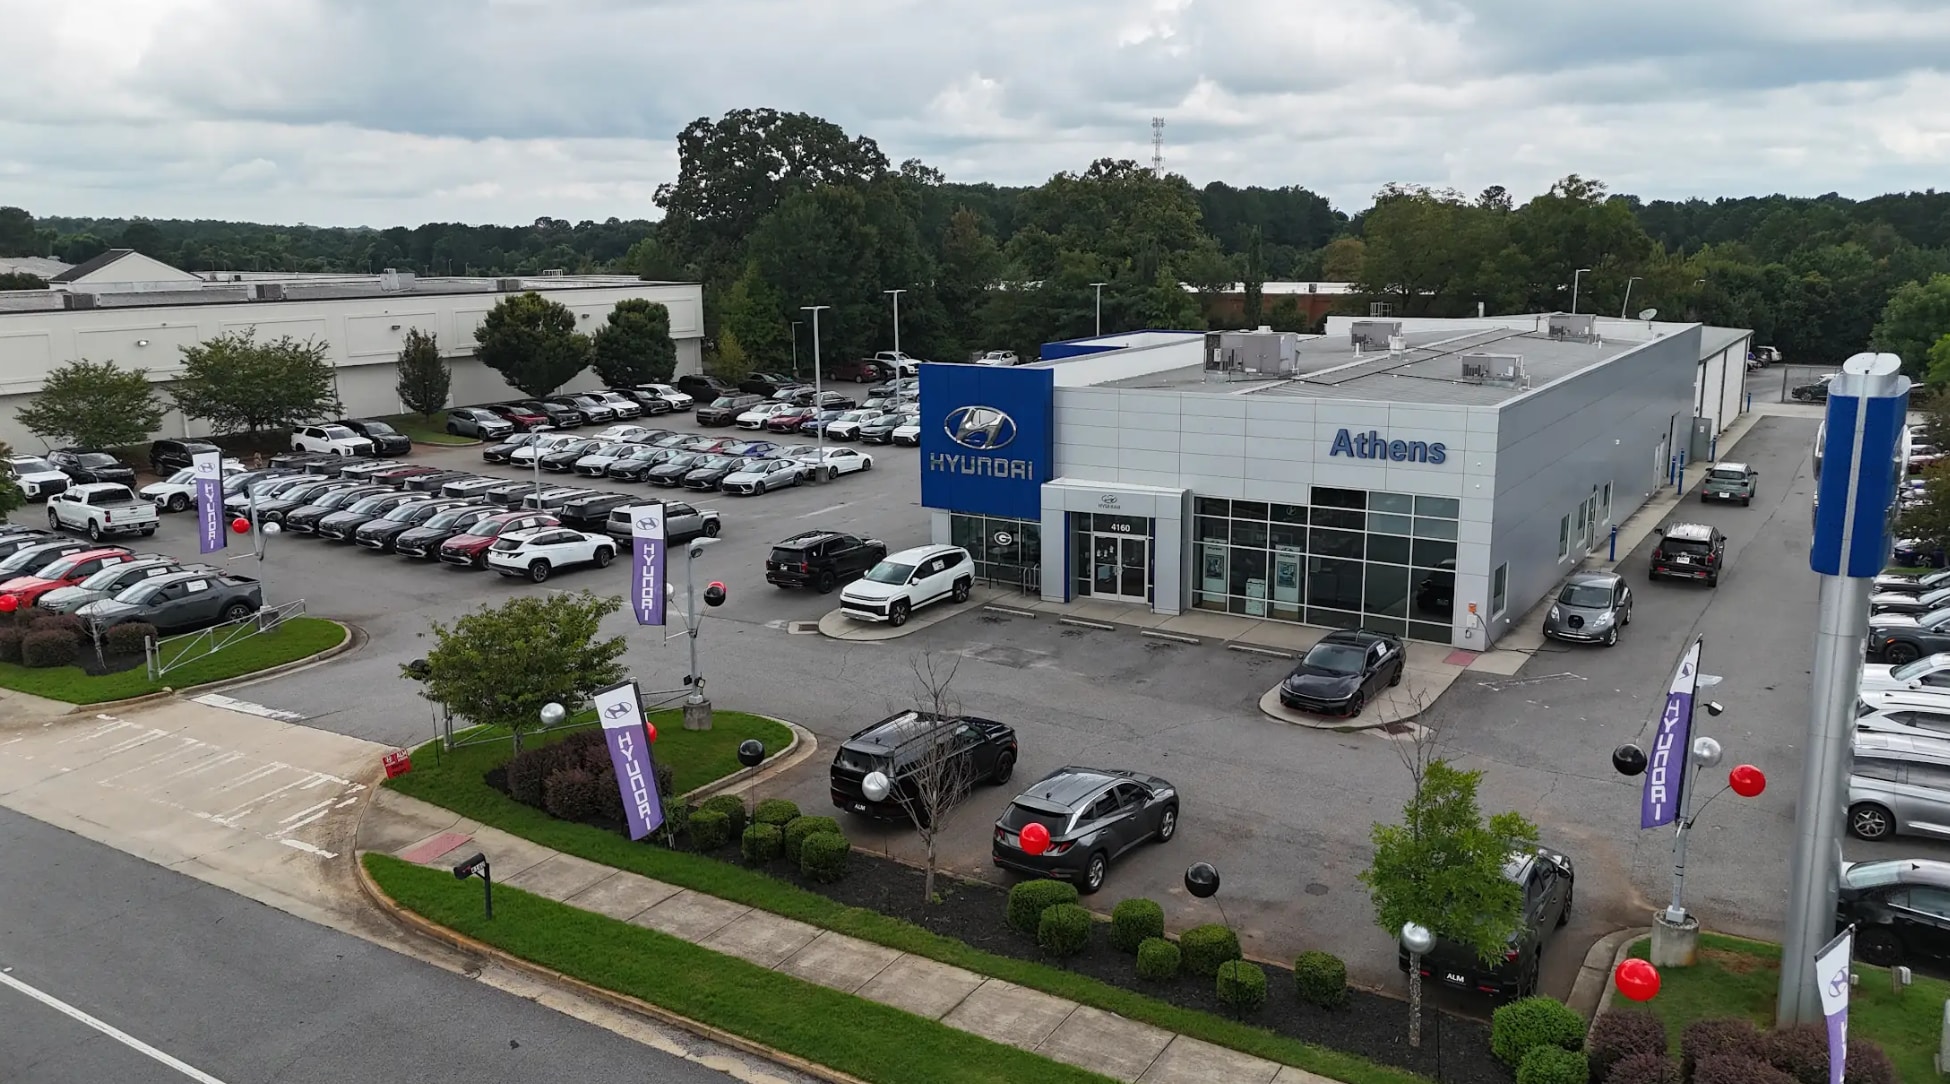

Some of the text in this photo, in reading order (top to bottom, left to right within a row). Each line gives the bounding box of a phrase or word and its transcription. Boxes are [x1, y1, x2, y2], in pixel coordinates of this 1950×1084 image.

[930, 452, 1033, 480] HYUNDAI
[1329, 428, 1447, 465] Athens
[204, 482, 217, 550] HYUNDAI
[1110, 523, 1131, 532] 4160
[641, 543, 656, 621] HYUNDAI
[617, 731, 651, 831] HYUNDAI
[1651, 699, 1680, 821] HYUNDAI
[1446, 972, 1465, 983] ALM
